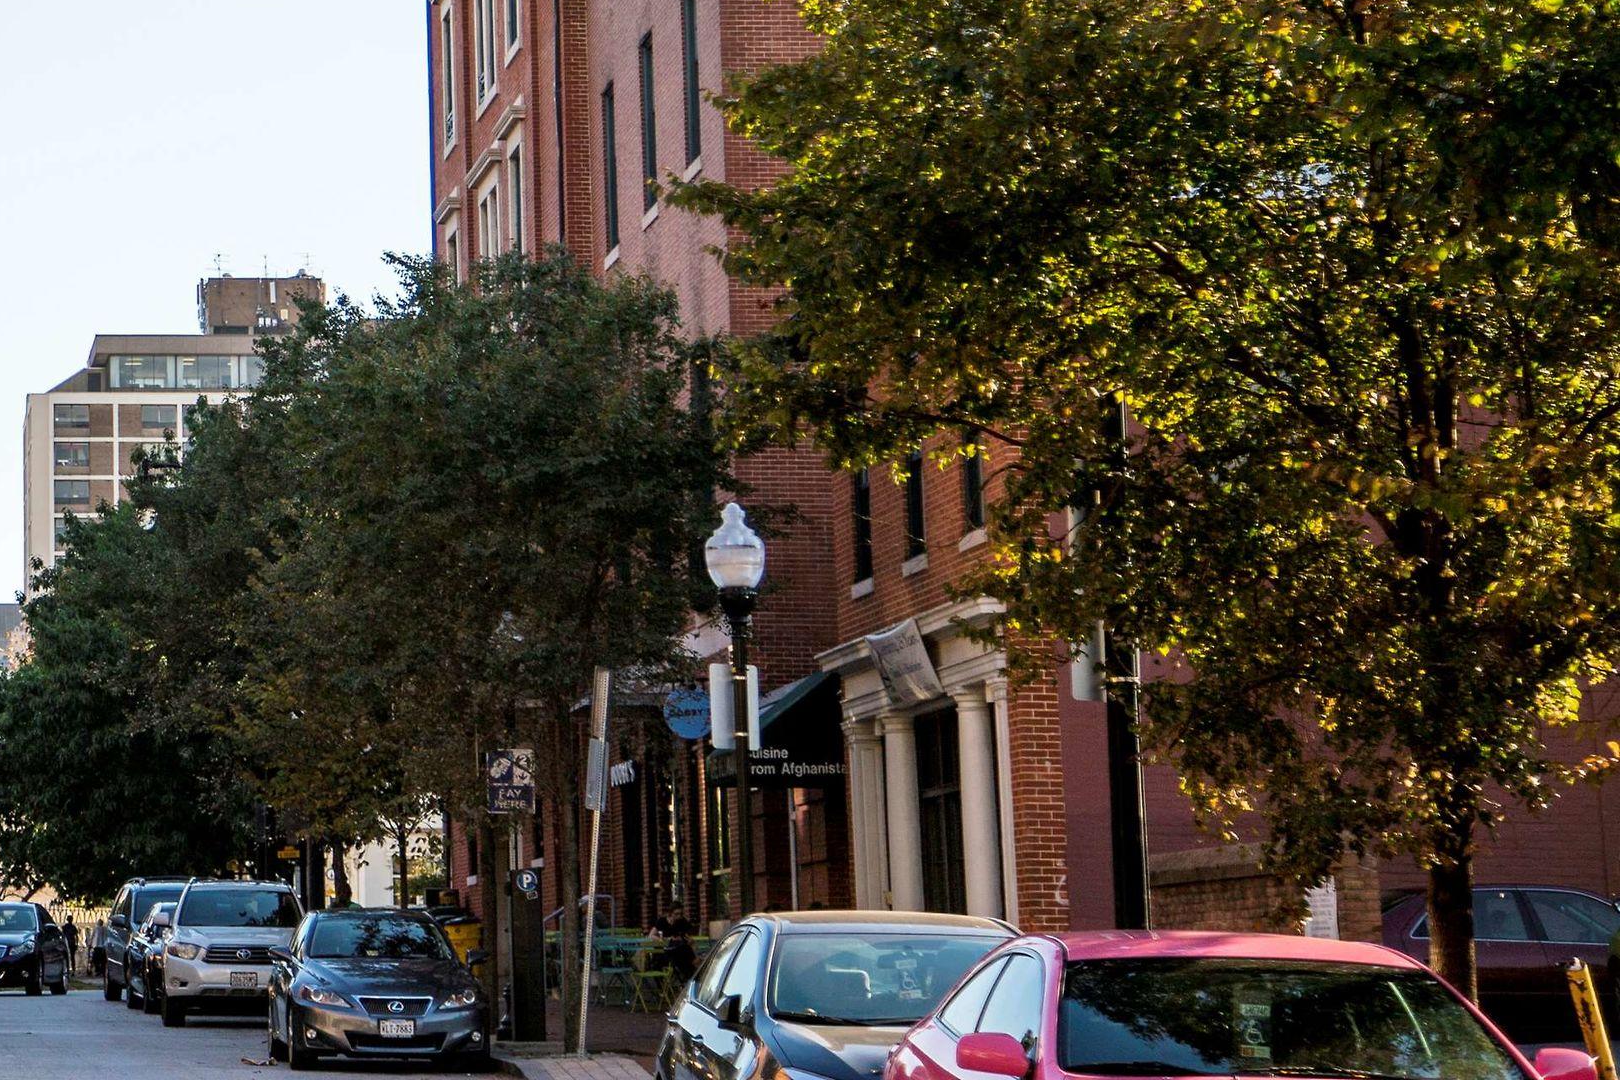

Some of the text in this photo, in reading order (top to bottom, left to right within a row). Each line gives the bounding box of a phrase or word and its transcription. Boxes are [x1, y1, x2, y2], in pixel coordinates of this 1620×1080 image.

[750, 747, 788, 759] uisine
[750, 762, 849, 777] rom Afghanista
